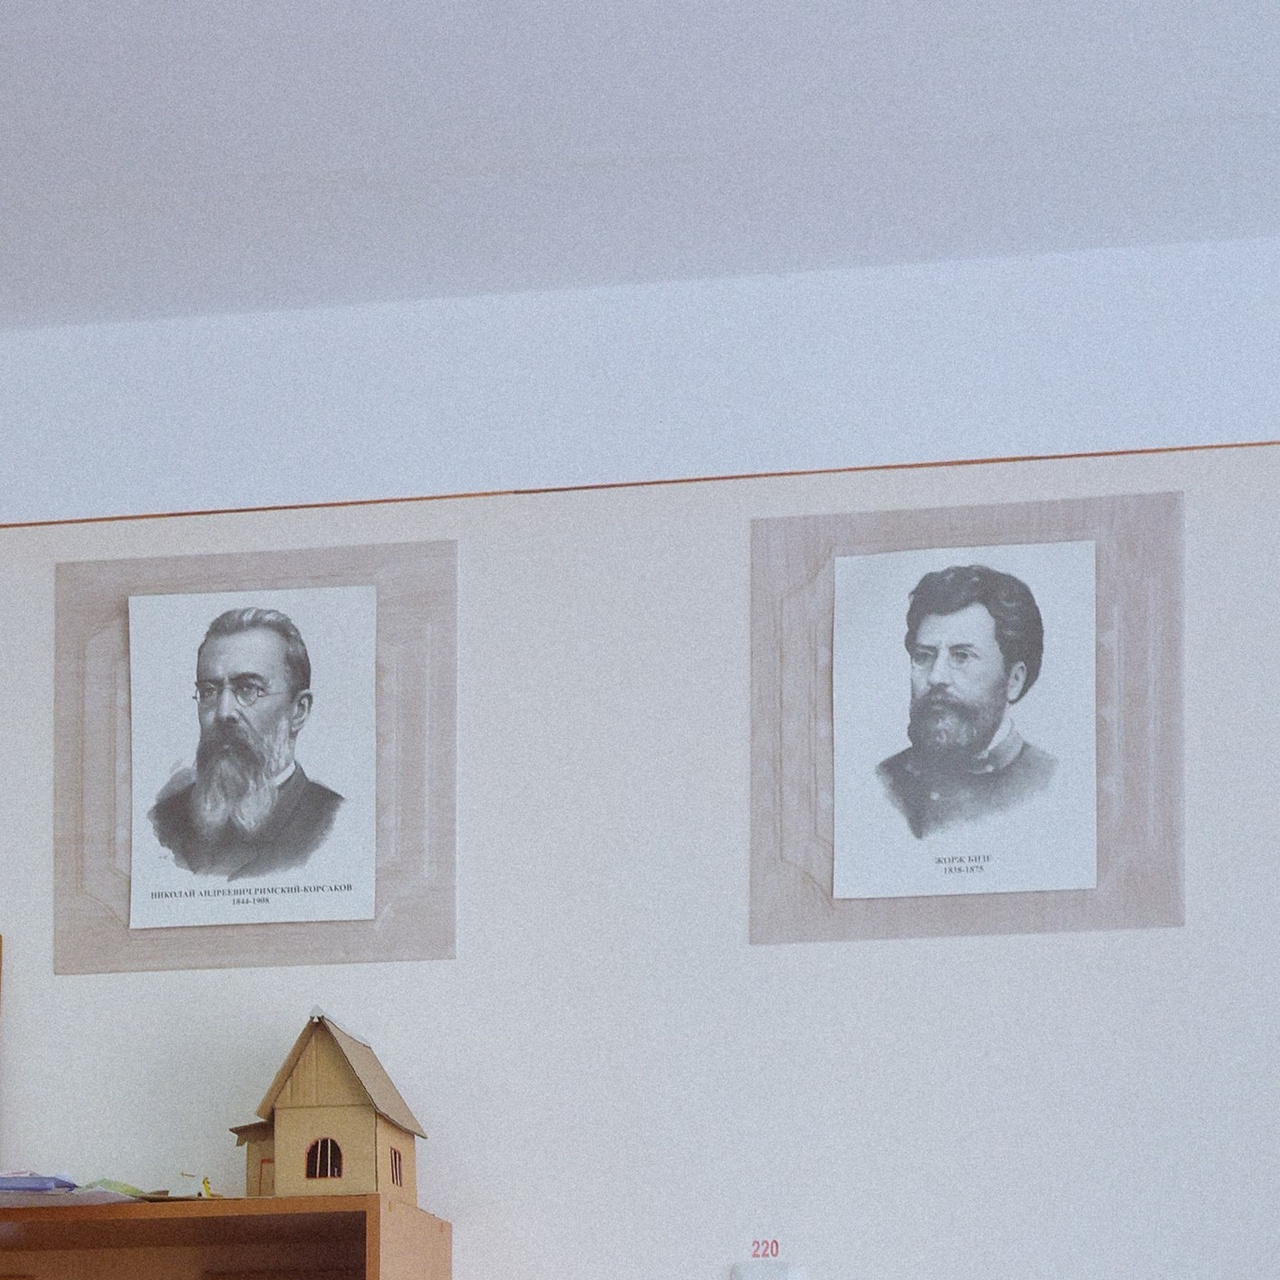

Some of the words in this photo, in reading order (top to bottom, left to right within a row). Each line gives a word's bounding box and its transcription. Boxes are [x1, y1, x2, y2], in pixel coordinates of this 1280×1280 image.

[150, 889, 196, 900] НИКОЛАЙ
[199, 887, 253, 898] АНДРЕЕВИЧ
[254, 884, 353, 895] РИМСКИЙ-КОРСАКОВ
[232, 897, 270, 905] 1844-1908
[751, 1239, 779, 1258] 220
